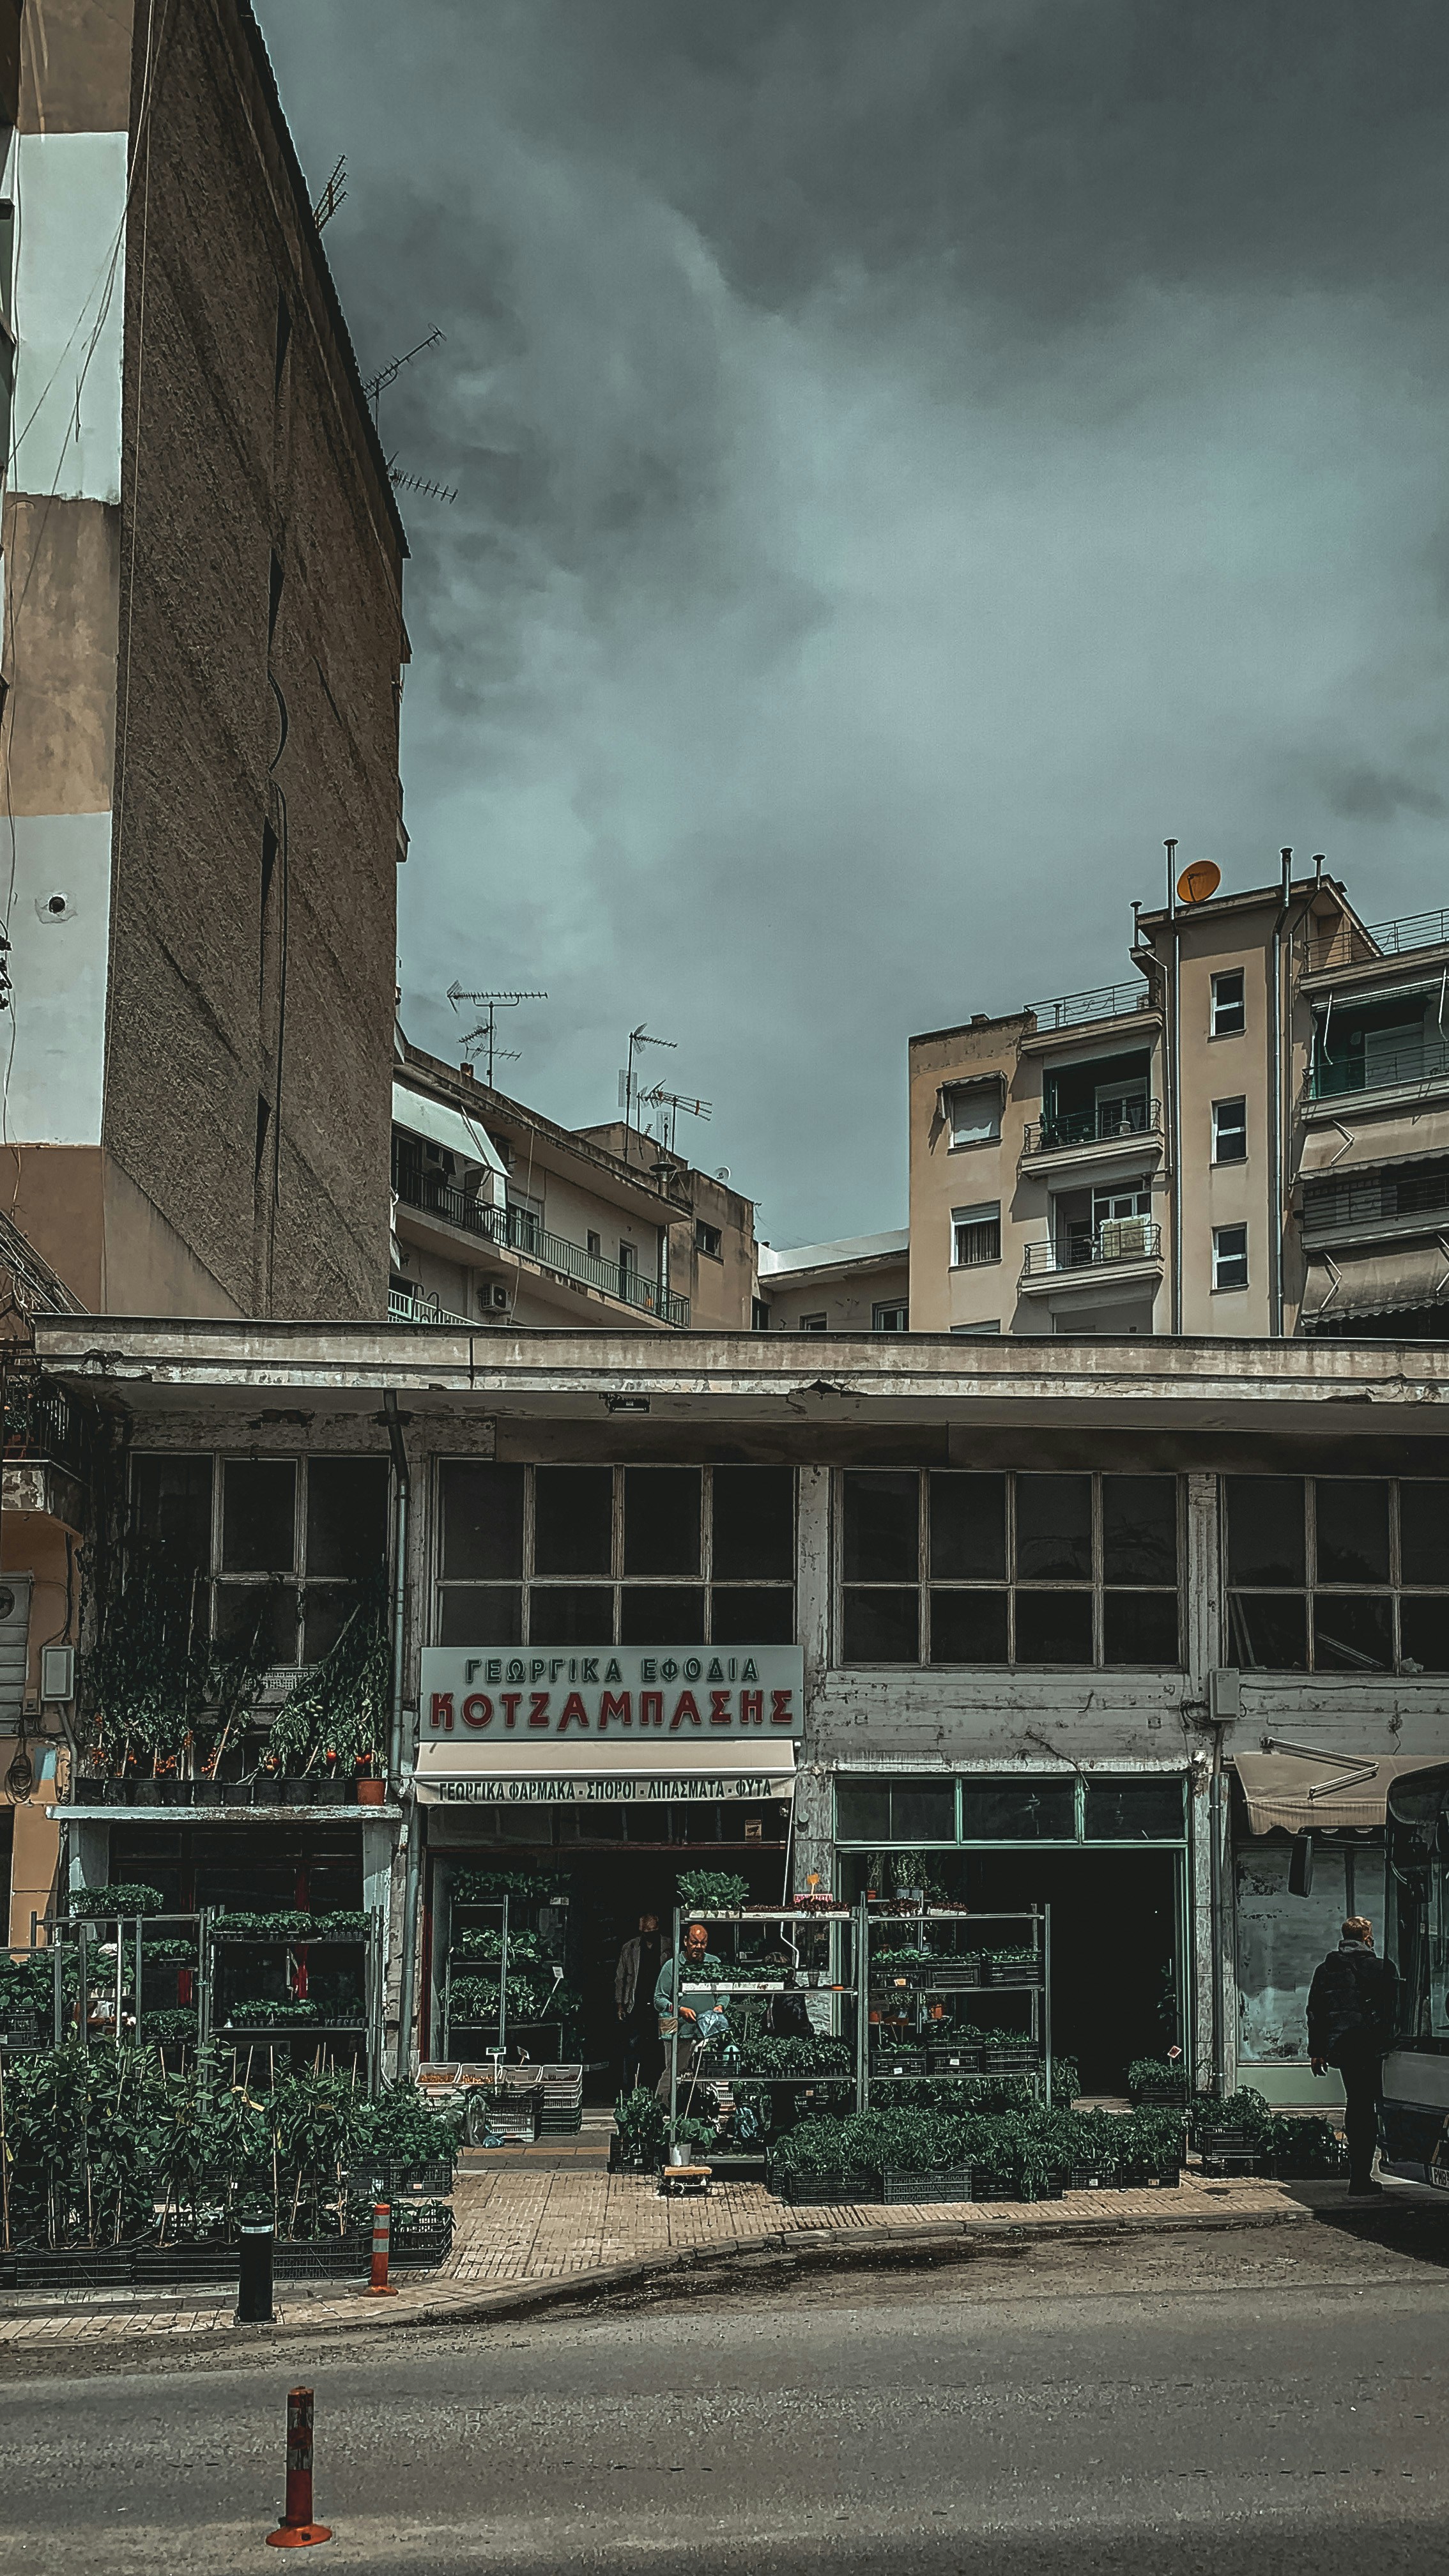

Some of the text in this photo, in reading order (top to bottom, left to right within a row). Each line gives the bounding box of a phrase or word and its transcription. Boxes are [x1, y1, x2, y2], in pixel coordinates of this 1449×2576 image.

[466, 1657, 758, 1682] ΓΕΩΡΓΙΚΑ ΕΦΟΔΙΑ
[431, 1690, 793, 1729] ΚΟΤΖΑΜΠΑΣΗΣ
[439, 1779, 772, 1801] ΓΕΩΡΓΙΚΑ ΦΑΡΜΑΚΑ ΣΠΟΡΟΙ ΛΙΠΑΣΜΑΤΑ ΦΥΤΑ
